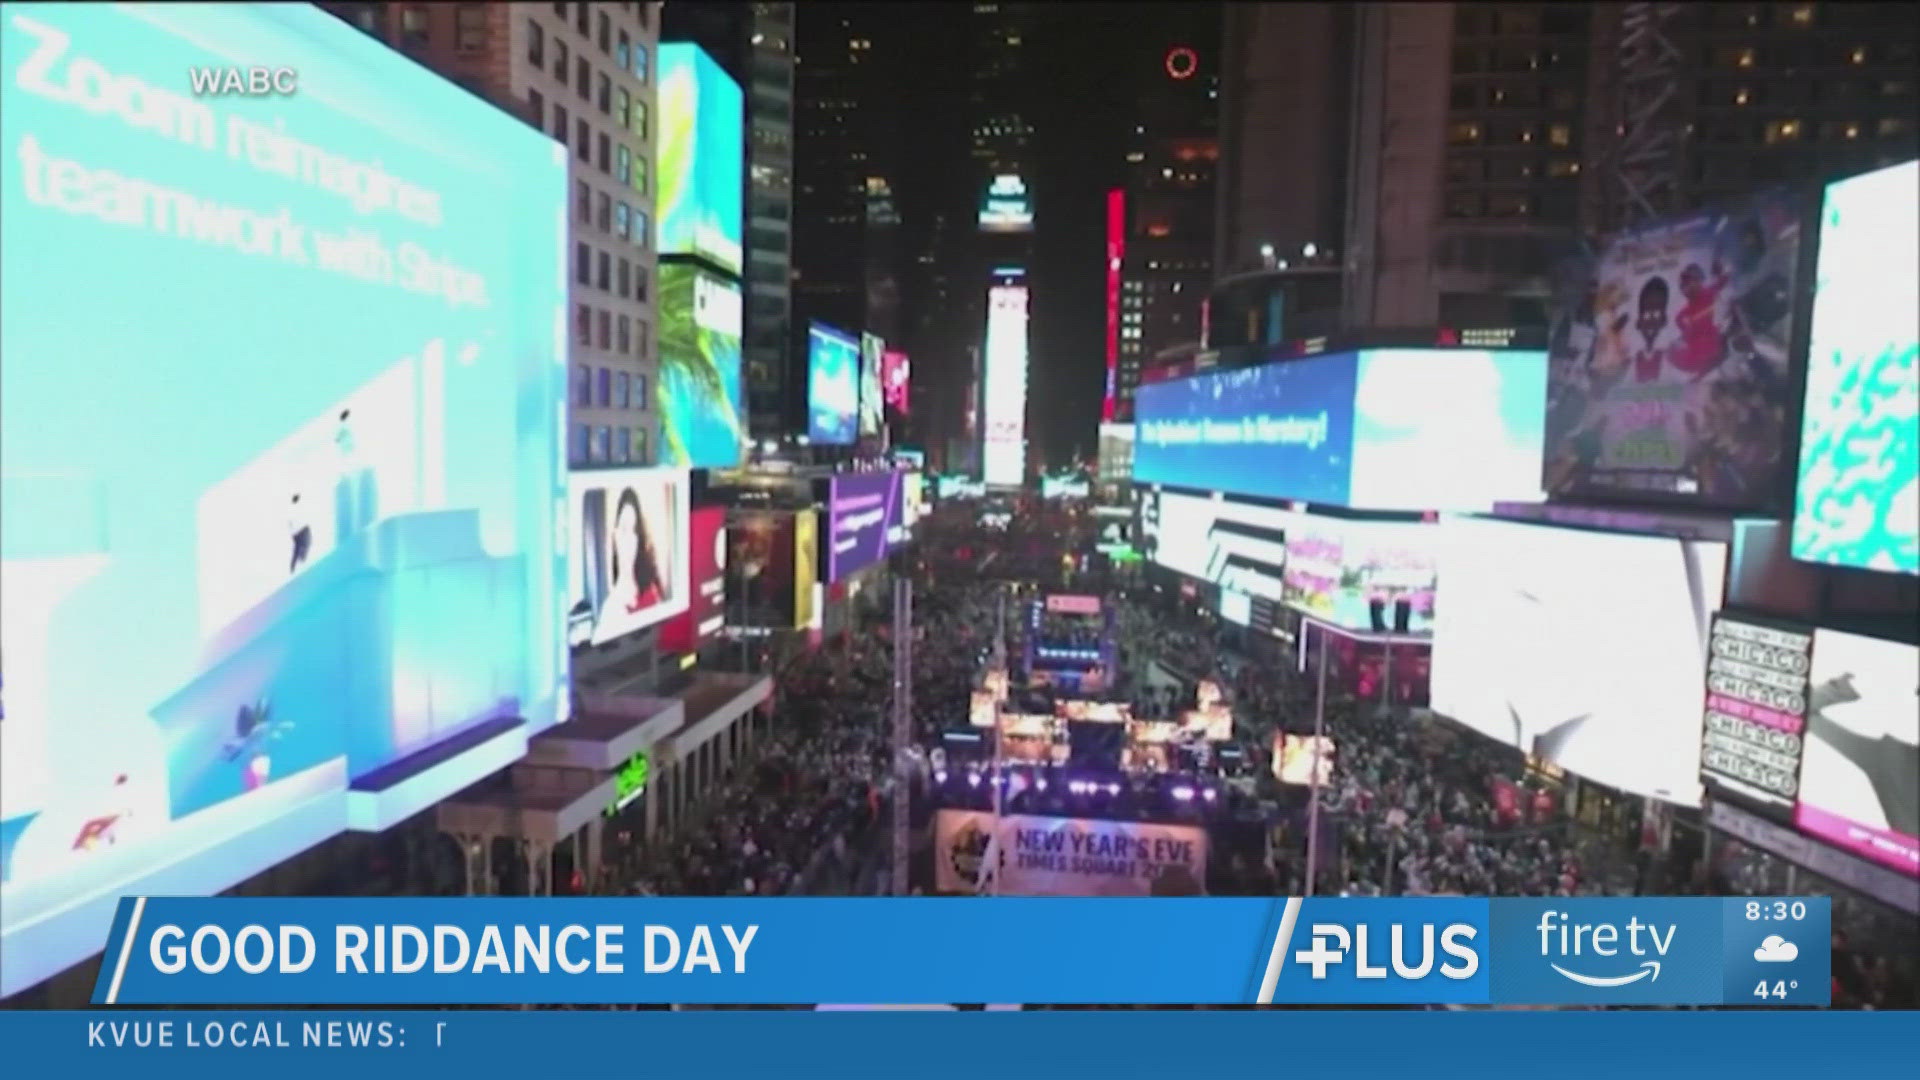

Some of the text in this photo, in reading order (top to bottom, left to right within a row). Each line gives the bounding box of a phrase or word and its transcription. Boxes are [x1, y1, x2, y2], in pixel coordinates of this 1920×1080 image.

[12, 13, 441, 229] Zoom reimagines
[18, 131, 311, 265] teamwork
[312, 225, 393, 287] with
[1712, 634, 1809, 676] CHICAGO
[1016, 829, 1194, 863] NEW YEAR'S EVE
[1017, 852, 1068, 872] TIMES
[1071, 855, 1136, 878] SQUARE
